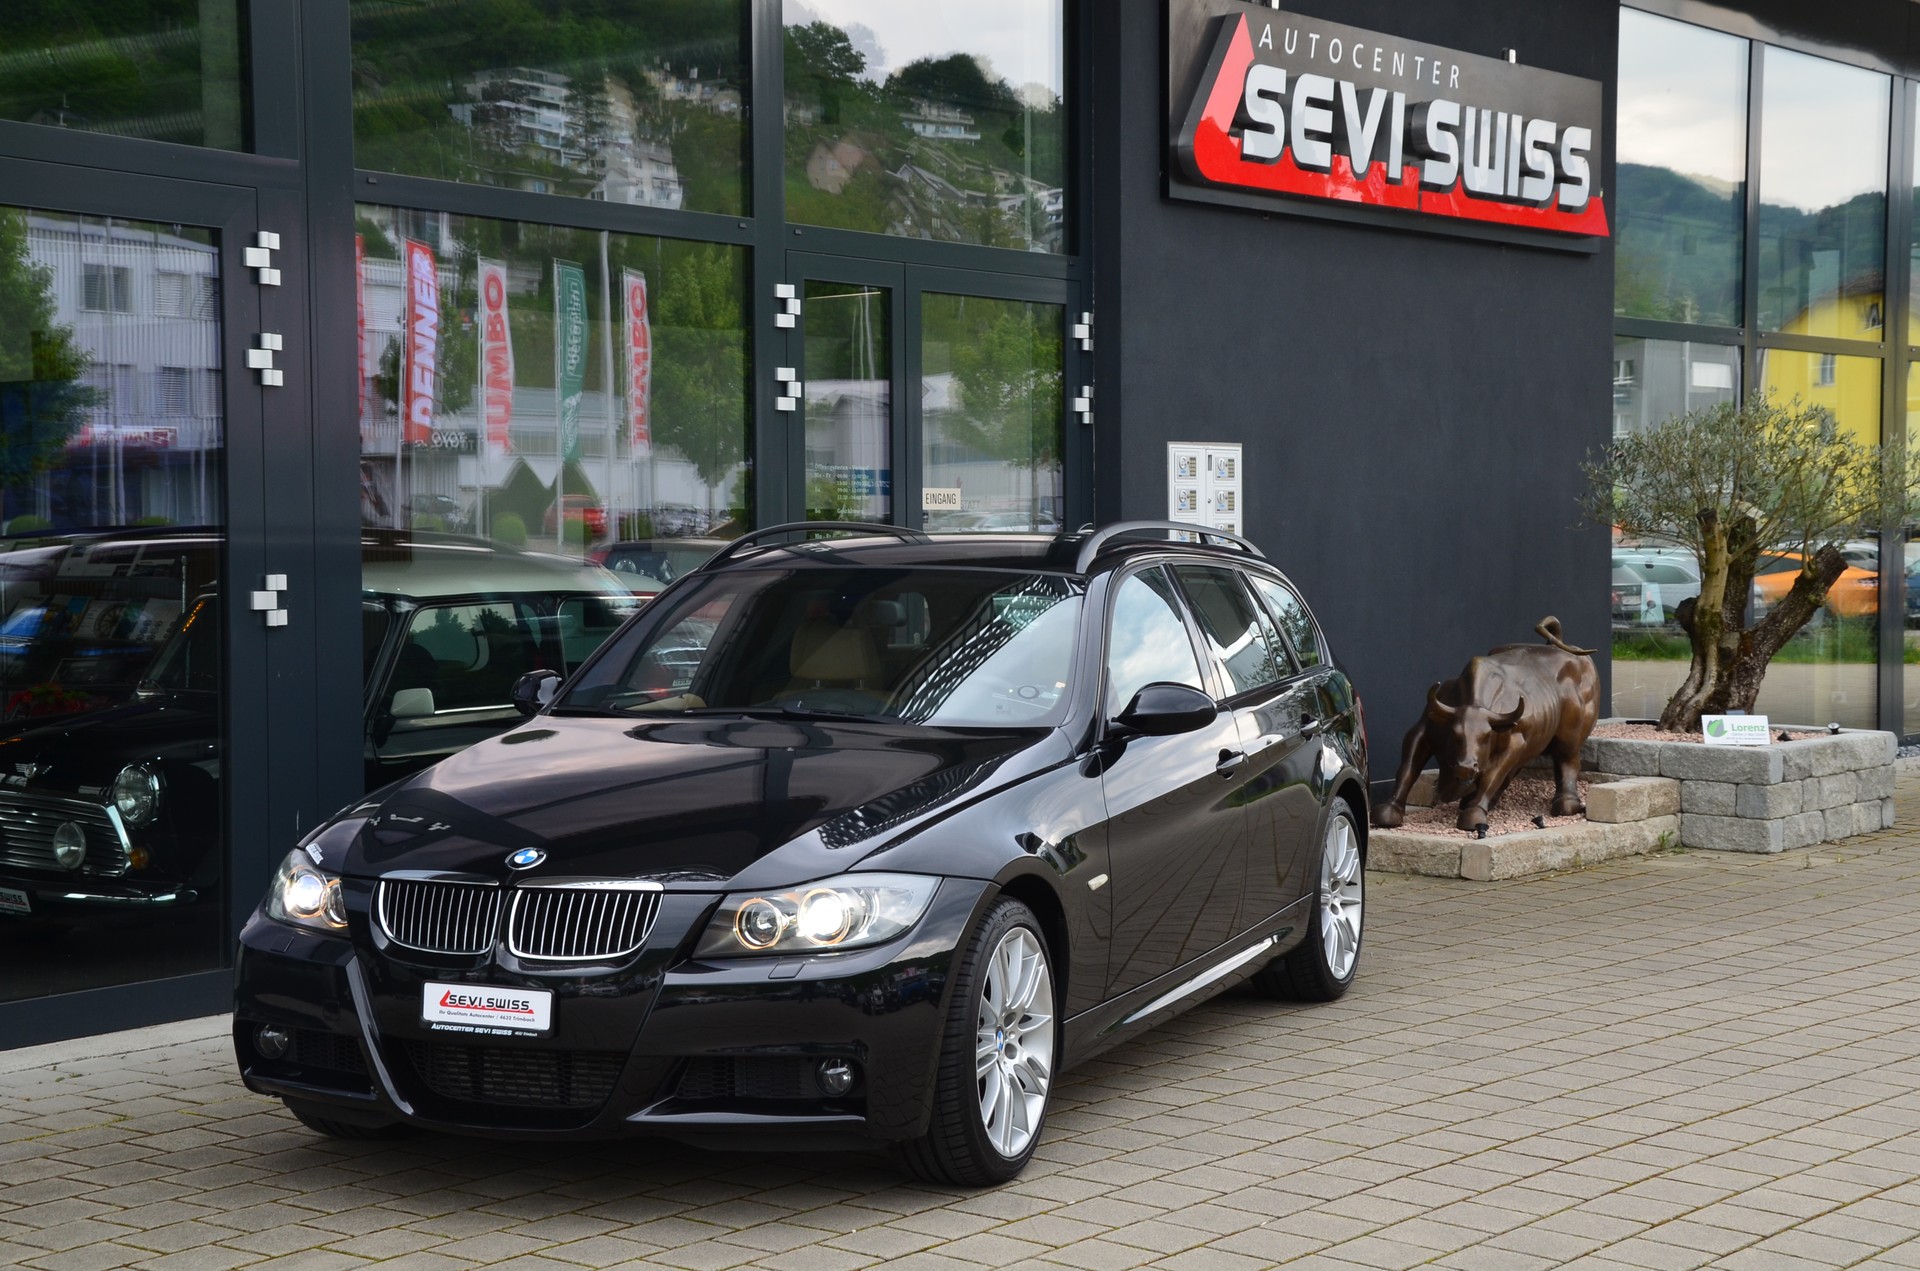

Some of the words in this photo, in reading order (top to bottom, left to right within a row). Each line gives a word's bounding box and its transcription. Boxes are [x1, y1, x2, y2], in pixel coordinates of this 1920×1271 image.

[1258, 23, 1459, 90] AUTOCENTER
[1242, 63, 1406, 180] SEVI
[1423, 98, 1592, 208] SWISS
[410, 246, 438, 428] DENNER
[484, 271, 512, 452] JUMBO
[630, 283, 651, 448] JUMBO
[925, 493, 957, 505] EINGANG
[1731, 723, 1767, 732] Lorenz
[448, 994, 482, 1007] SEVI
[486, 997, 530, 1011] SWISS
